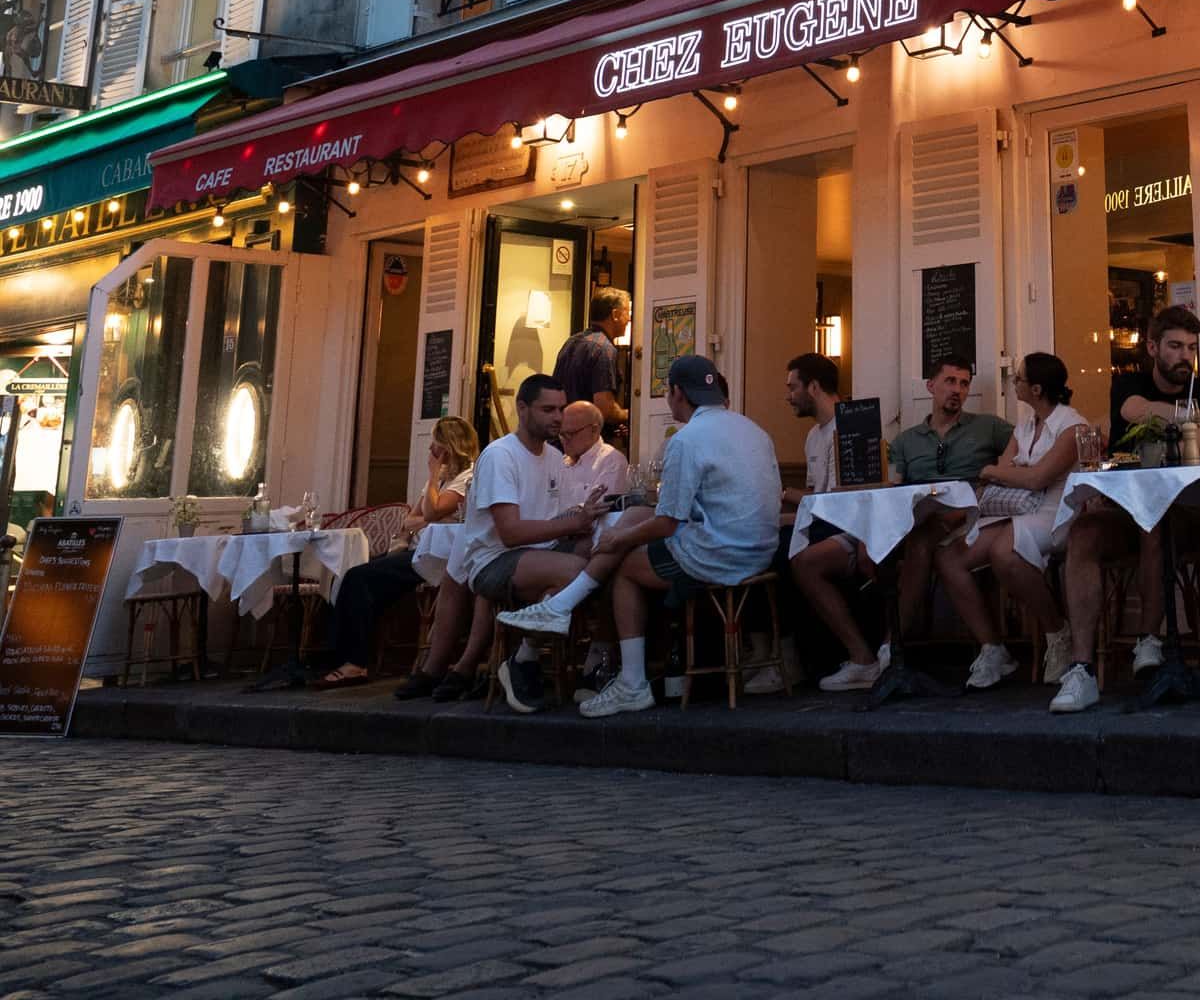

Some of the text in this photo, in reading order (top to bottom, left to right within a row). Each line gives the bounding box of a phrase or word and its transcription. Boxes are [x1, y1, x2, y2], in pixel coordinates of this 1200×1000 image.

[594, 30, 703, 98] CHEZ
[195, 134, 363, 192] CAFE RESTAURANT
[13, 185, 44, 217] 1900
